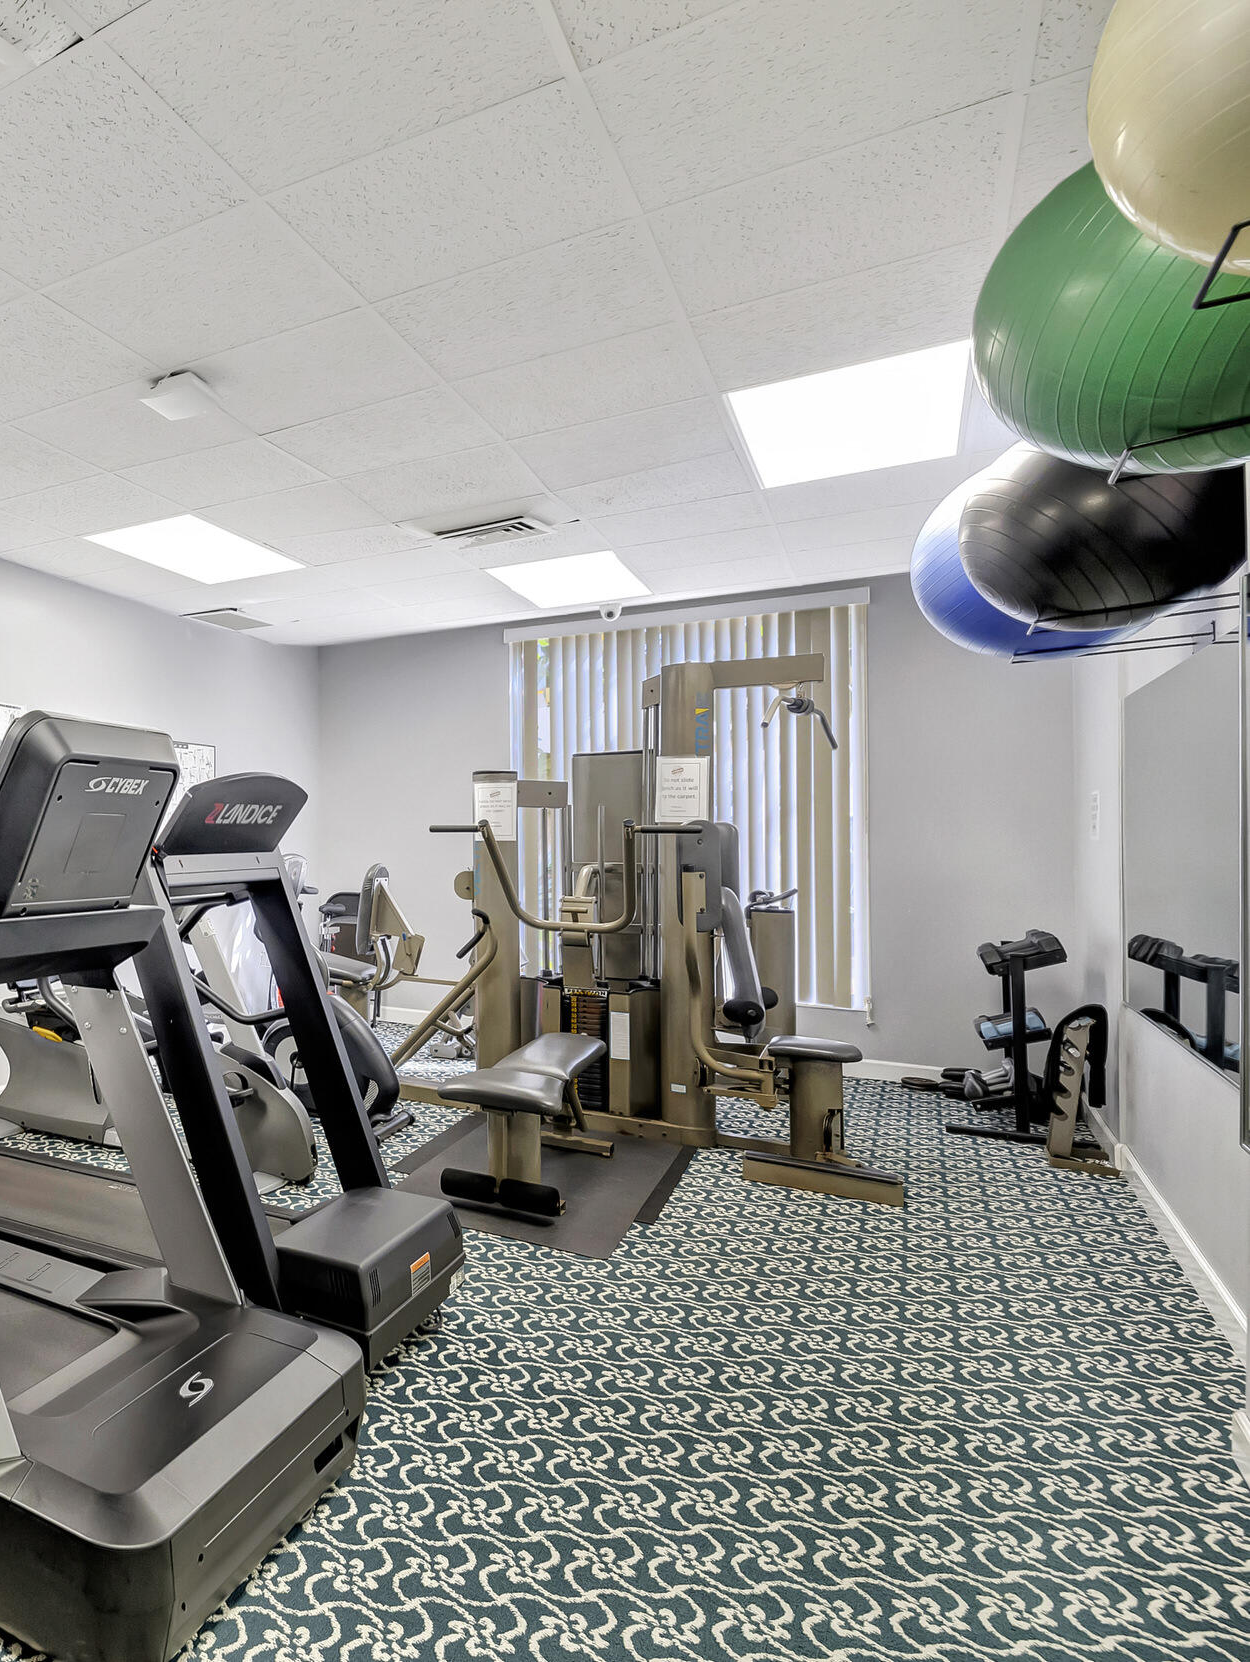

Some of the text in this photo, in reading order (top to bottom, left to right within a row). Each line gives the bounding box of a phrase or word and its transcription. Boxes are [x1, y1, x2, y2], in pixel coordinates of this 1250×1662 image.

[695, 706, 711, 757] TRA
[105, 777, 150, 795] CYBEX
[215, 803, 283, 825] LANDICE
